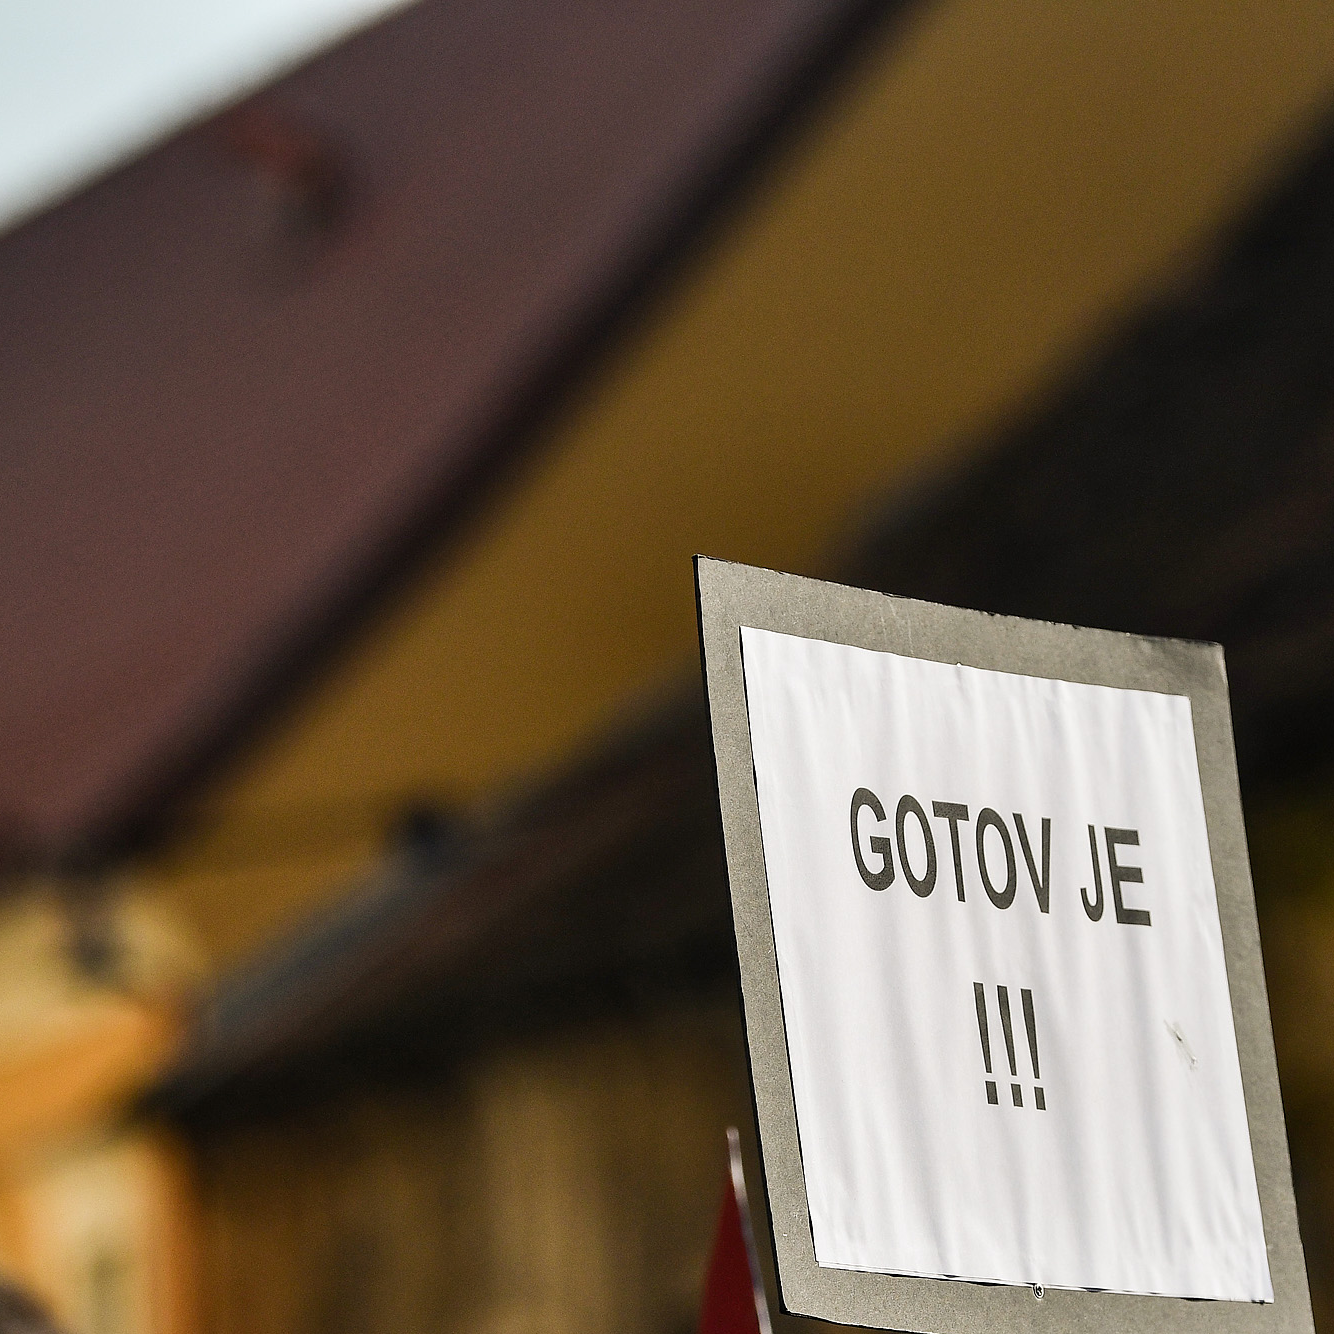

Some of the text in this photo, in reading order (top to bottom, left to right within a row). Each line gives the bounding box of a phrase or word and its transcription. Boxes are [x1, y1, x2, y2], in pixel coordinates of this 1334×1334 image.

[850, 787, 1152, 927] GOTOV JE
[972, 981, 1047, 1111] !!!
